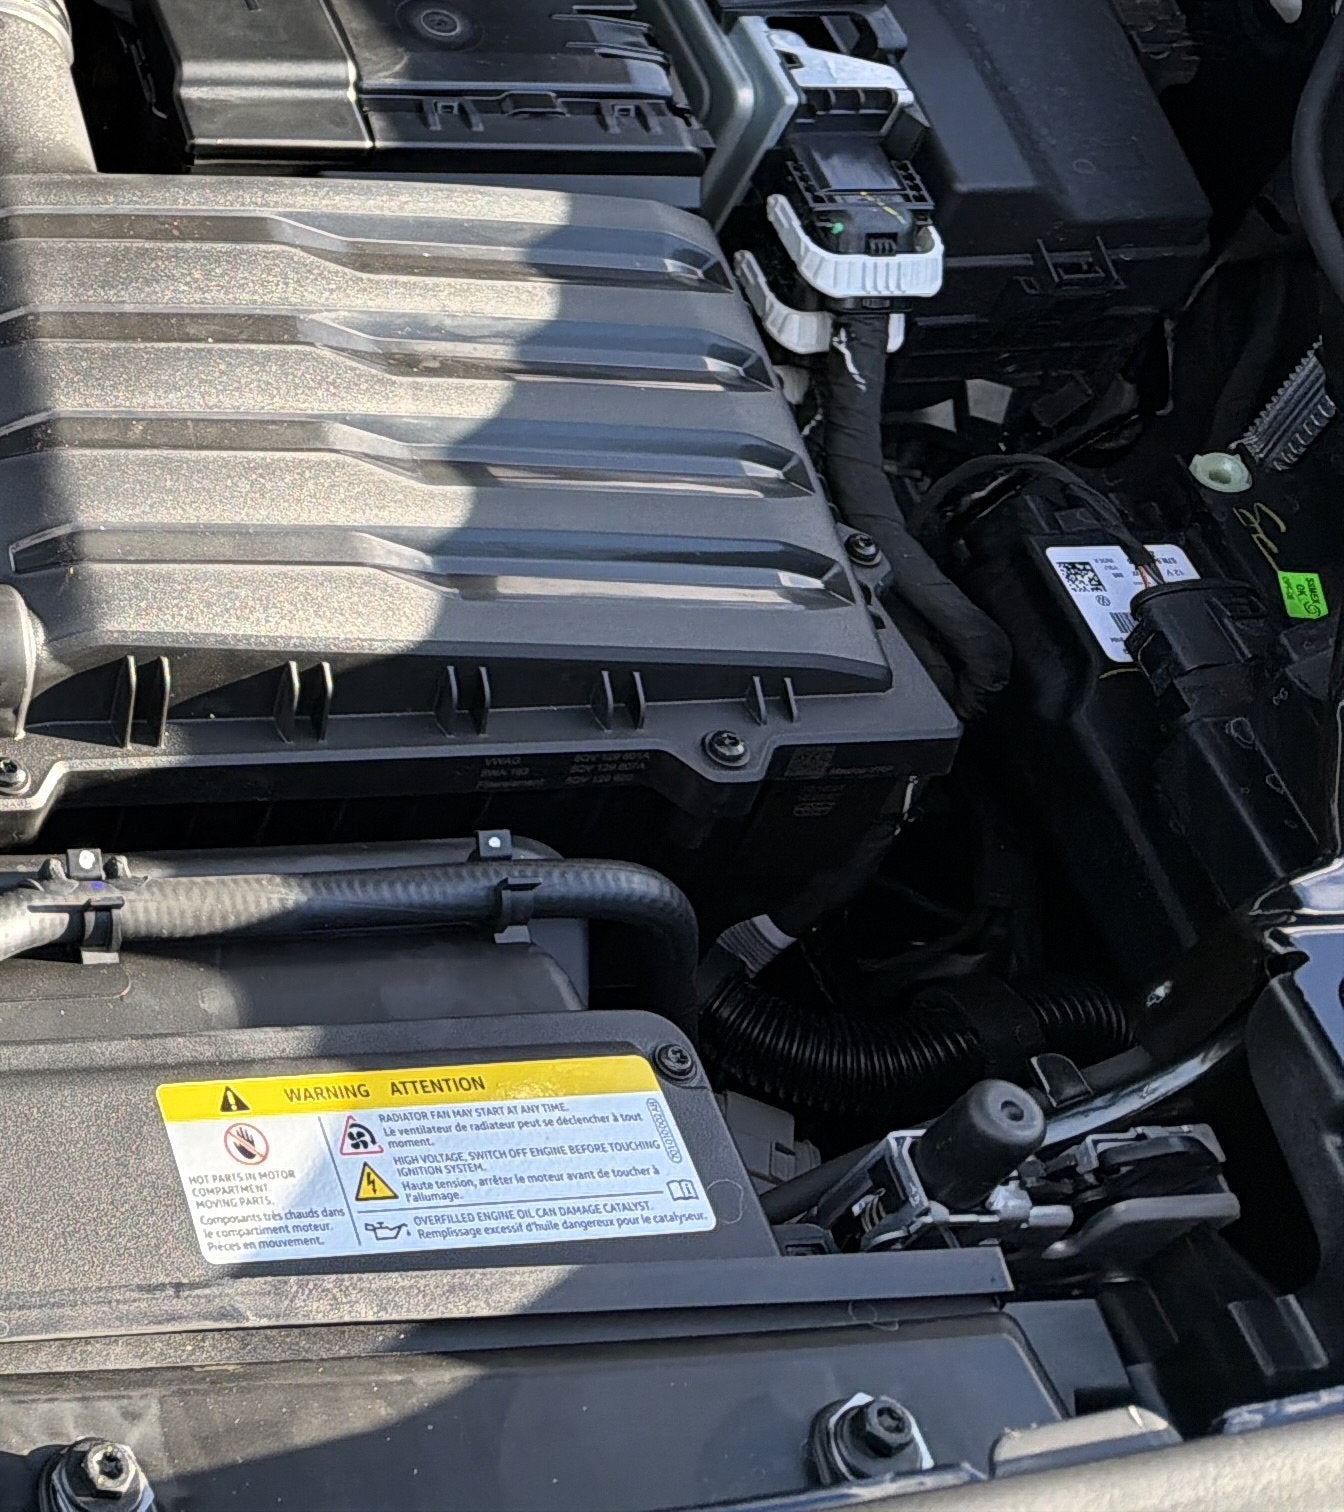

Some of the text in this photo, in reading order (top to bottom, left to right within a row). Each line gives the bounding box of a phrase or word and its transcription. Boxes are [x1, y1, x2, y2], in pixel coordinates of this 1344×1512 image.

[284, 1076, 486, 1103] WARNING ATTENTION
[379, 1102, 570, 1124] RADIATOR FAN MAY START AT ANY TIME.
[399, 1124, 453, 1136] ventilateur
[455, 1122, 467, 1133] de
[469, 1120, 516, 1132] radiateur
[518, 1119, 542, 1131] peut
[543, 1119, 554, 1128] se
[556, 1113, 610, 1127] déclencher
[612, 1112, 619, 1122] à
[621, 1112, 643, 1122] tout
[388, 1137, 435, 1149] moment.
[393, 1139, 661, 1166] HIGH VOLTAGE, SWITCH OFF ENGINE BEFORE TOUCHING
[188, 1169, 296, 1186] HOT PARTS IN MOTOR
[397, 1162, 486, 1177] IGNITION SYSTEM.
[401, 1164, 660, 1192] Haute tension, arrêter le moteur avant de toucher à
[196, 1198, 238, 1210] MOVING
[405, 1192, 463, 1203] l'allumage.
[200, 1207, 345, 1227] Composants très chauds dans
[413, 1200, 653, 1227] OVERFILLED ENGINE OIL CAN DAMAGE CATALYST.
[203, 1222, 334, 1240] le compartiment moteur.
[418, 1211, 708, 1241] Remplissage excessif d'huile dangereux pour le catalyseur.
[243, 1240, 257, 1251] en
[258, 1236, 325, 1250] mouvement.
